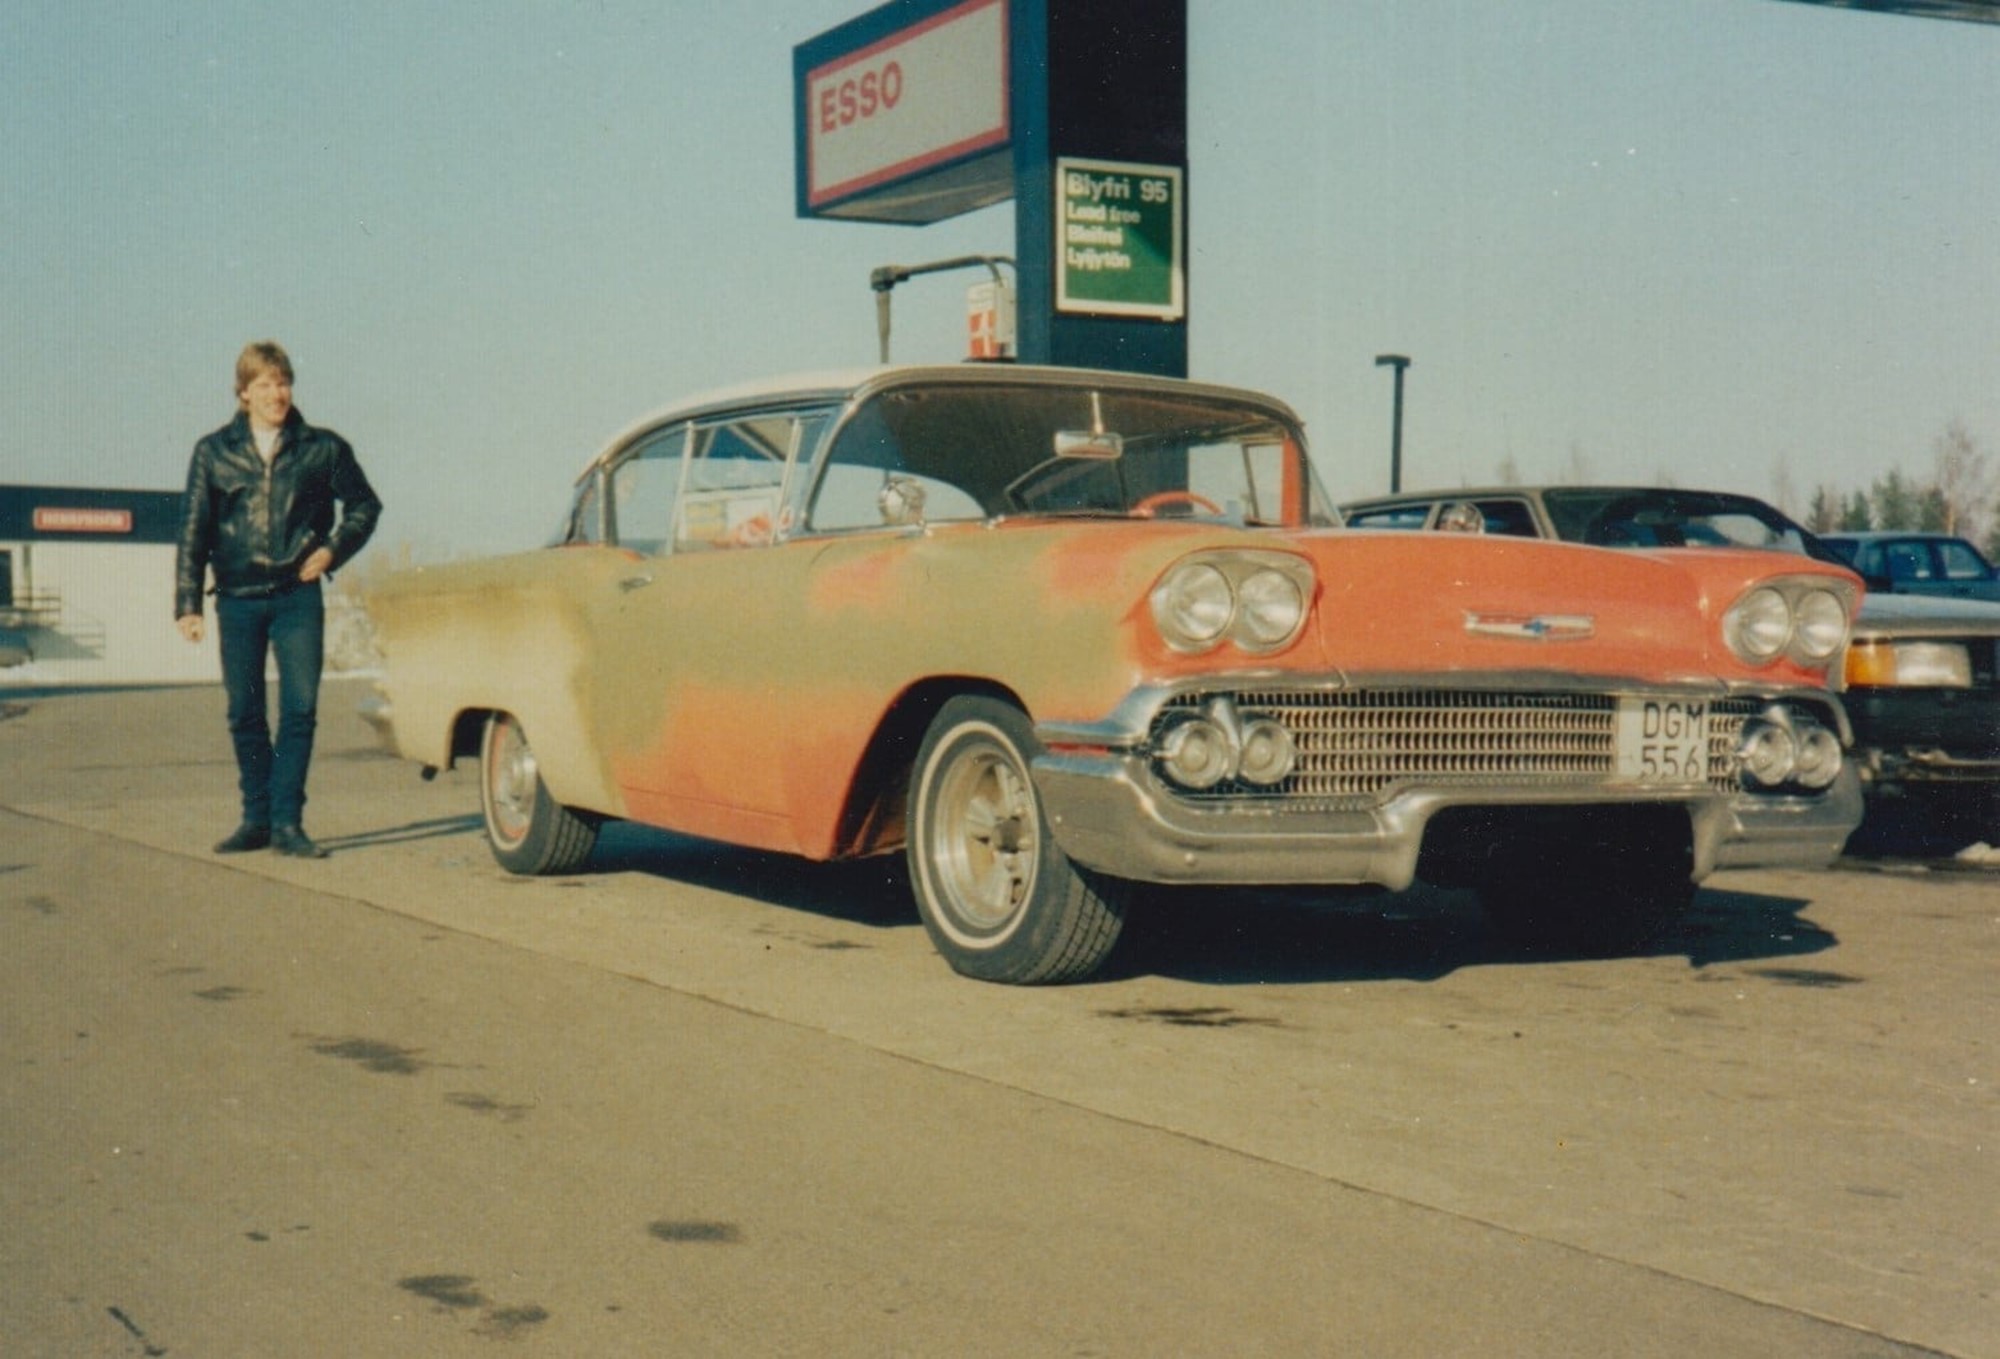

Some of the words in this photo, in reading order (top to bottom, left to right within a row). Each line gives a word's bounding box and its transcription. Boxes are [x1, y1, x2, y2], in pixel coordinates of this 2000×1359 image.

[820, 60, 903, 133] ESSO
[1067, 173, 1130, 202] Blyfri
[1140, 179, 1168, 203] 95
[1643, 702, 1704, 739] DGM
[1640, 745, 1700, 781] 556
